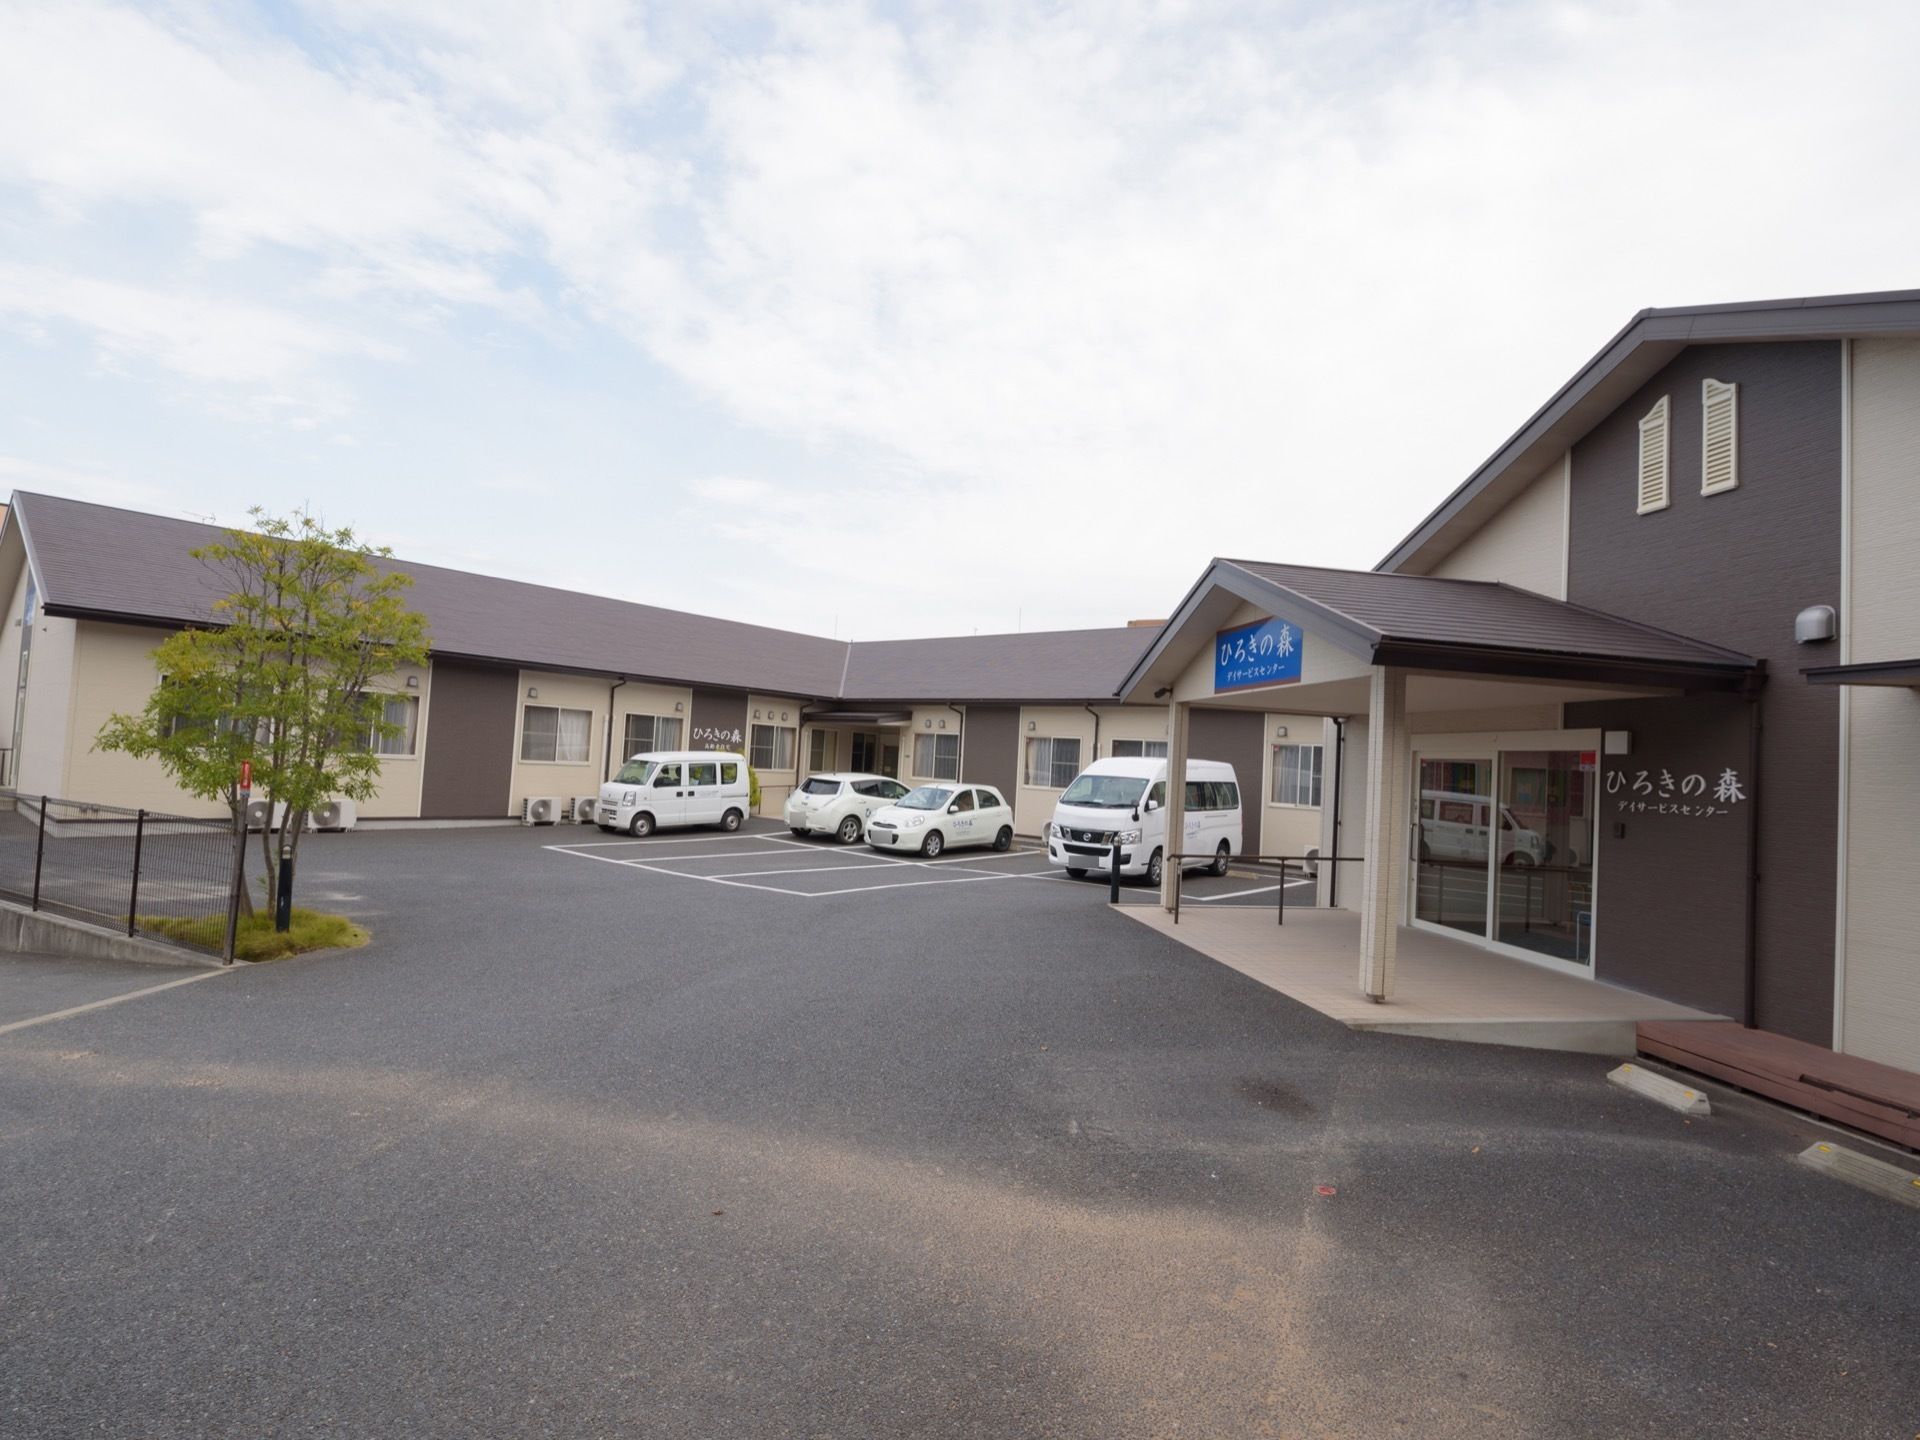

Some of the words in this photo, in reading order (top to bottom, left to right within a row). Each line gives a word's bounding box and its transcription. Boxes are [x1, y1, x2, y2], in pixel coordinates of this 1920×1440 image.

[1221, 624, 1294, 666] ひろきの森
[693, 727, 742, 743] ひろきの森
[1606, 767, 1746, 803] ひろきの森
[1618, 801, 1728, 817] デイサービスセンター
